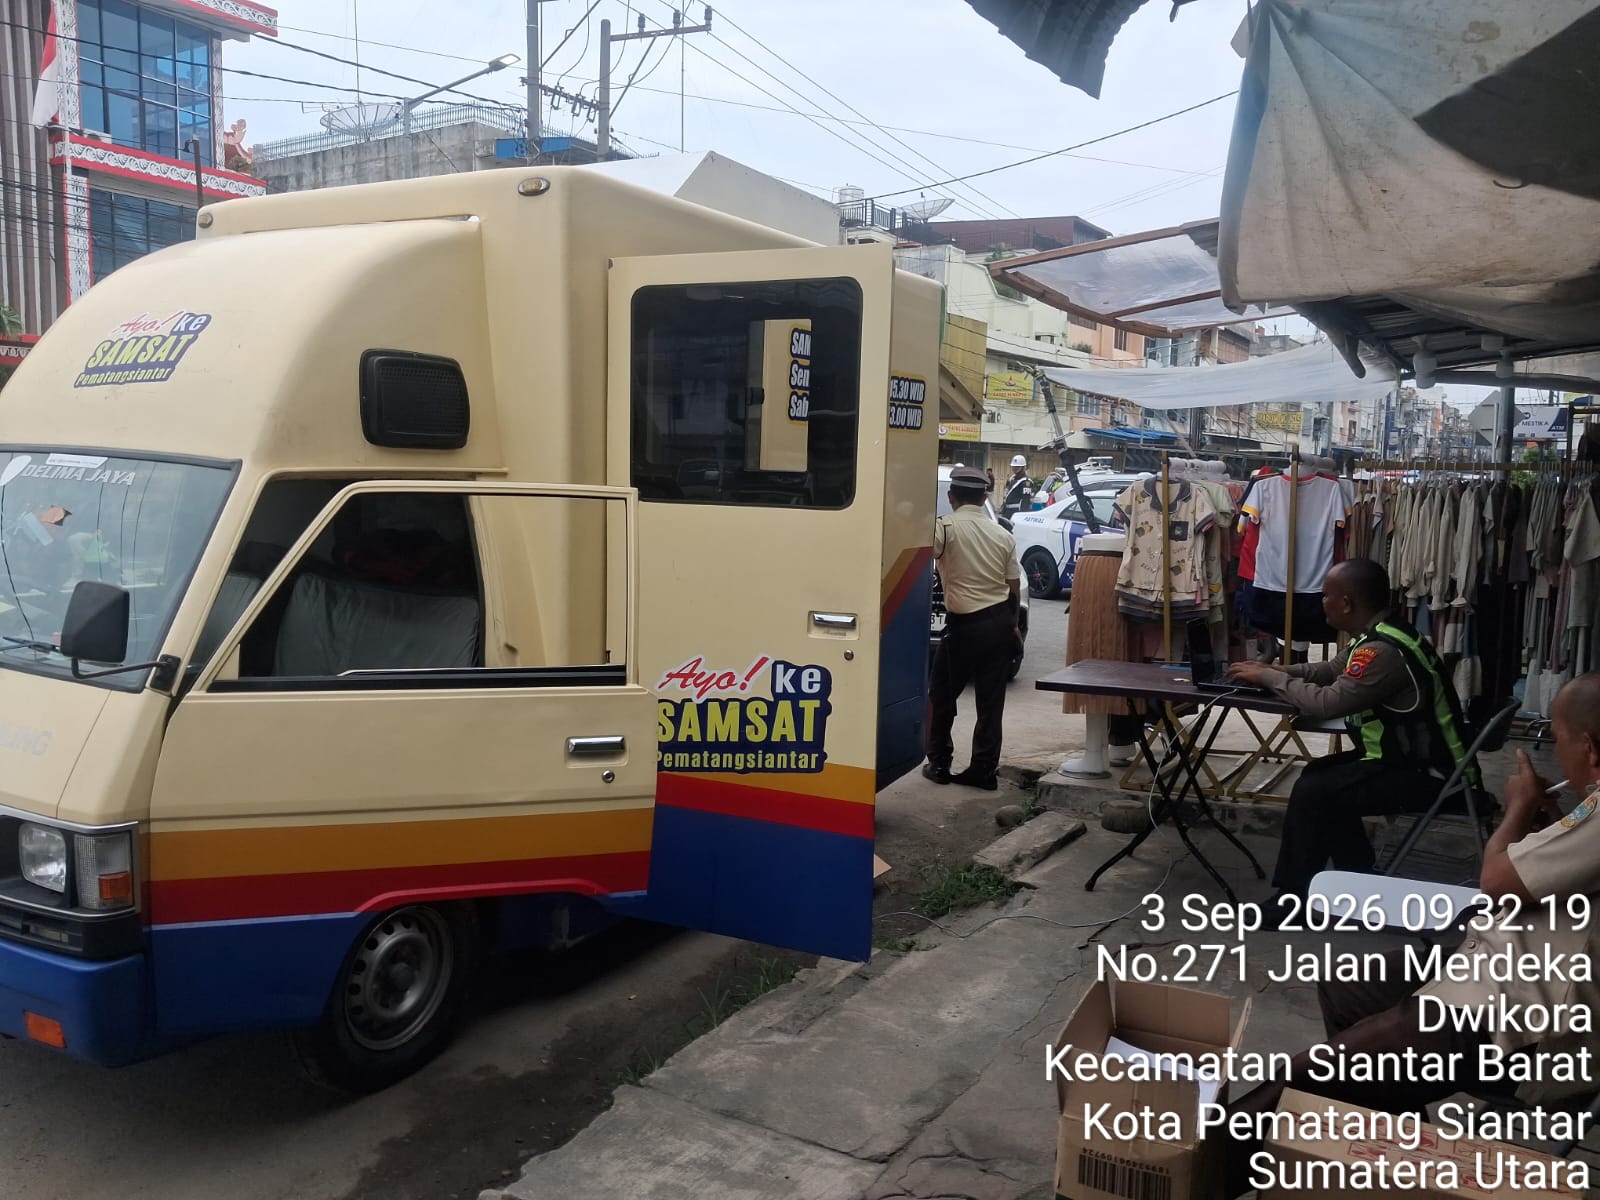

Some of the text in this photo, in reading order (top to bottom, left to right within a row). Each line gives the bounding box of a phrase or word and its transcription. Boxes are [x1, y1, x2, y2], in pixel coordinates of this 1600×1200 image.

[112, 311, 207, 337] Ayo! ke
[87, 333, 195, 368] SAMSAT
[75, 368, 171, 386] Pematangsiantar
[909, 382, 924, 402] WIB
[906, 408, 922, 428] WIB
[21, 464, 136, 486] DELIMA JAYA
[658, 656, 821, 699] Ayo! ke
[658, 700, 821, 742] SAMSAT
